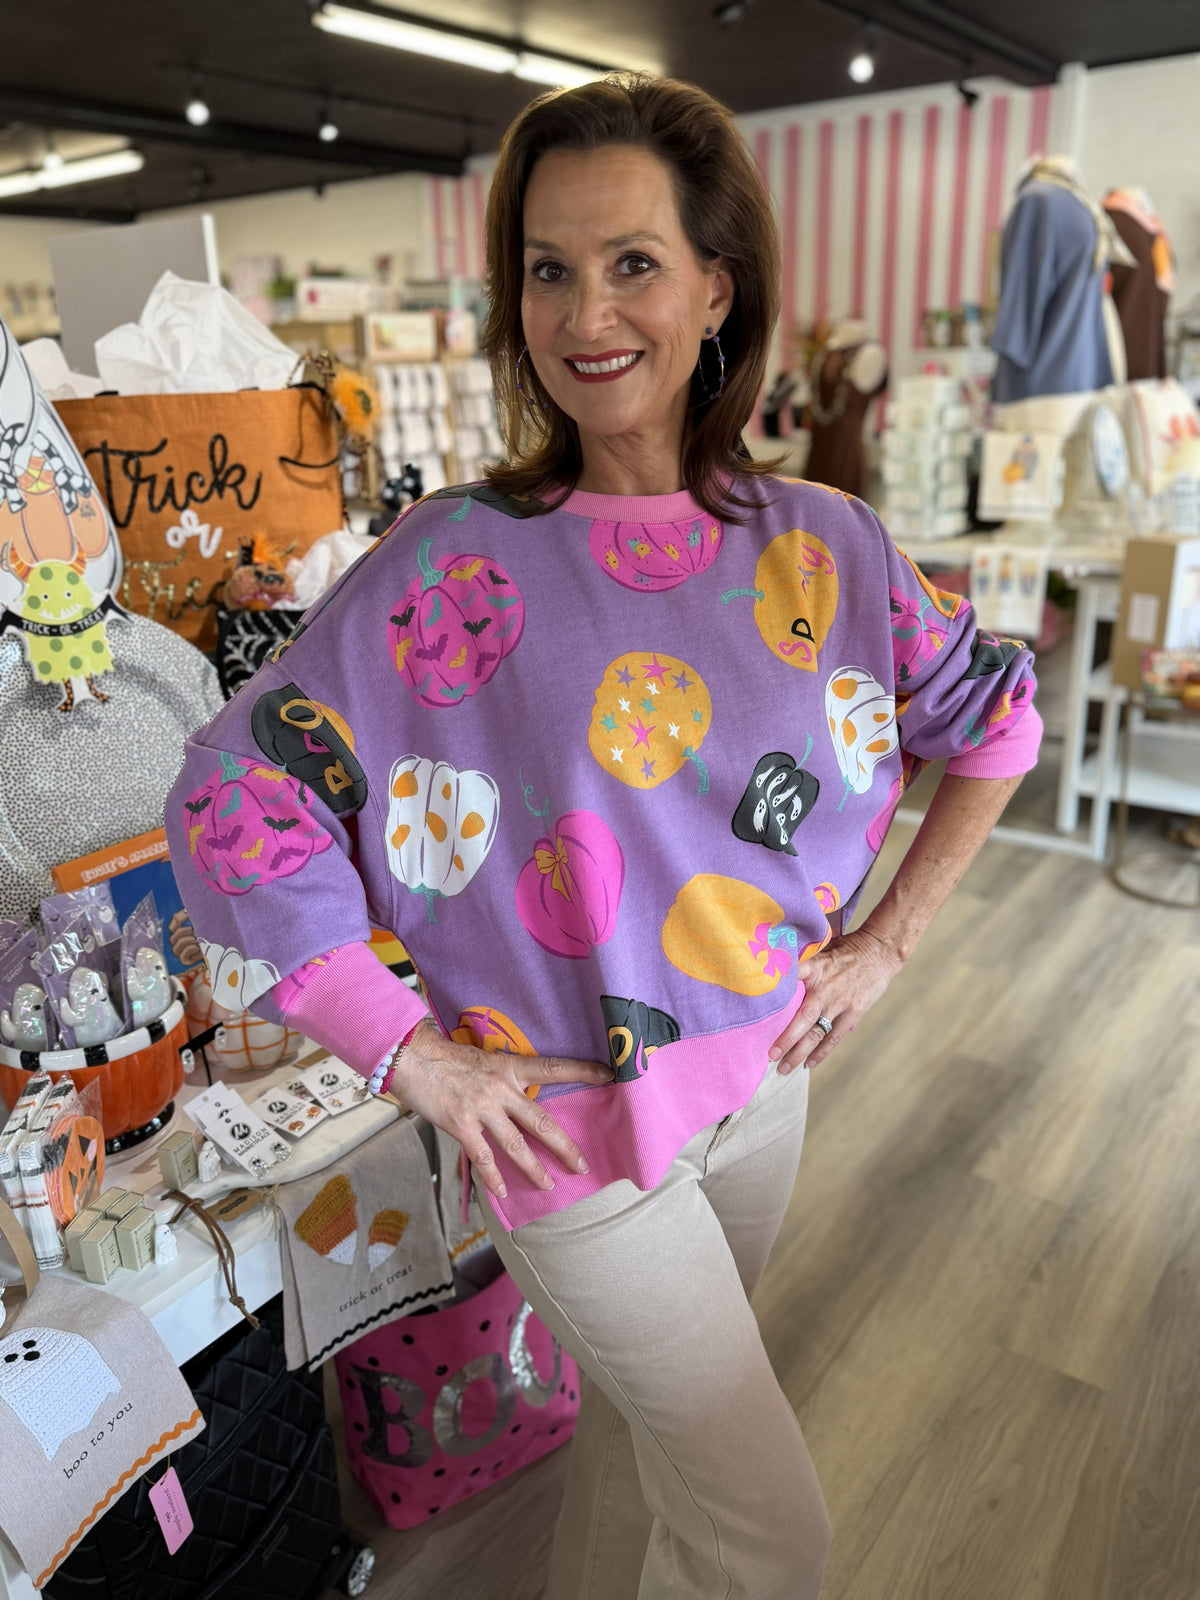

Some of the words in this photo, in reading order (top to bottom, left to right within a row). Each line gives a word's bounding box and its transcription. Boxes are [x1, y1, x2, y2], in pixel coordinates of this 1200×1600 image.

[84, 434, 262, 528] Trick
[166, 510, 222, 558] or
[233, 1127, 268, 1153] MADISON
[238, 1131, 271, 1156] MARKETPLACE
[339, 1289, 367, 1313] trick
[370, 1283, 384, 1295] or
[386, 1264, 413, 1285] treat
[350, 1300, 562, 1468] BOO
[63, 1450, 89, 1479] boo
[90, 1430, 105, 1447] to
[107, 1402, 133, 1432] you
